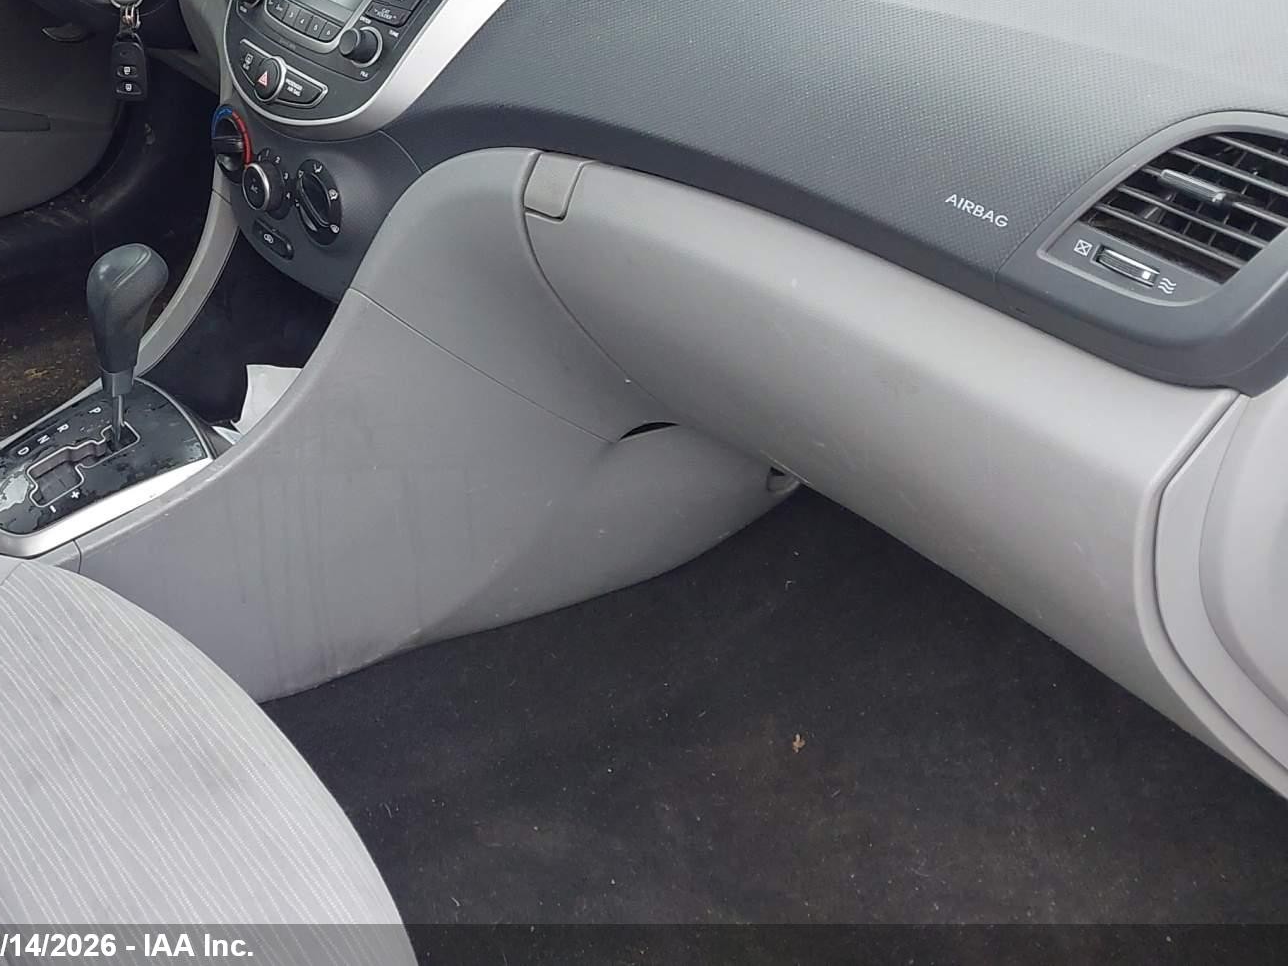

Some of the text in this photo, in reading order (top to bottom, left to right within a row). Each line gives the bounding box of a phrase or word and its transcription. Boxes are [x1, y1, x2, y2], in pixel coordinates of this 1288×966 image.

[945, 192, 1010, 229] AIRBAG
[88, 406, 102, 415] P
[56, 423, 70, 433] R
[36, 434, 50, 446] N
[17, 445, 32, 457] D
